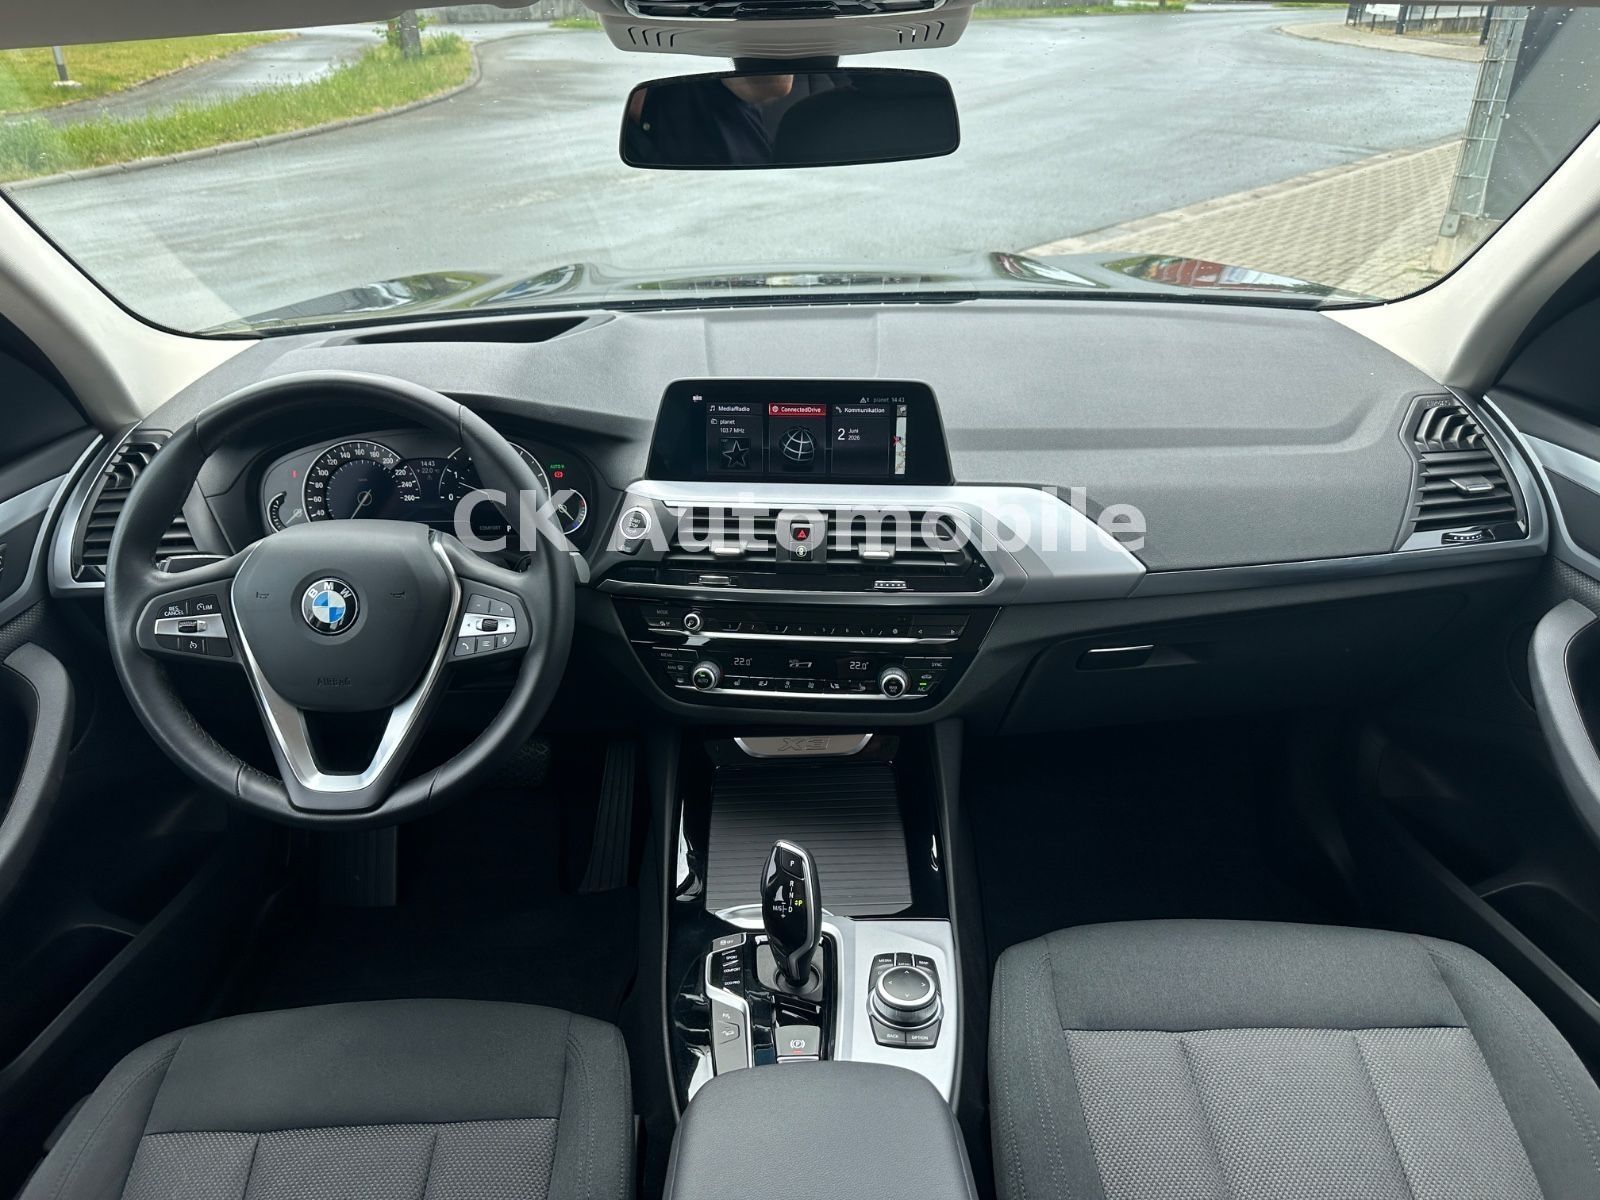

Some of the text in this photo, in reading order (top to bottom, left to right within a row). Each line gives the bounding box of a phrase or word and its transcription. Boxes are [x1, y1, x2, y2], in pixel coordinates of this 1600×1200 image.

[837, 428, 846, 440] 2
[308, 582, 352, 599] BMW
[777, 736, 830, 751] X3
